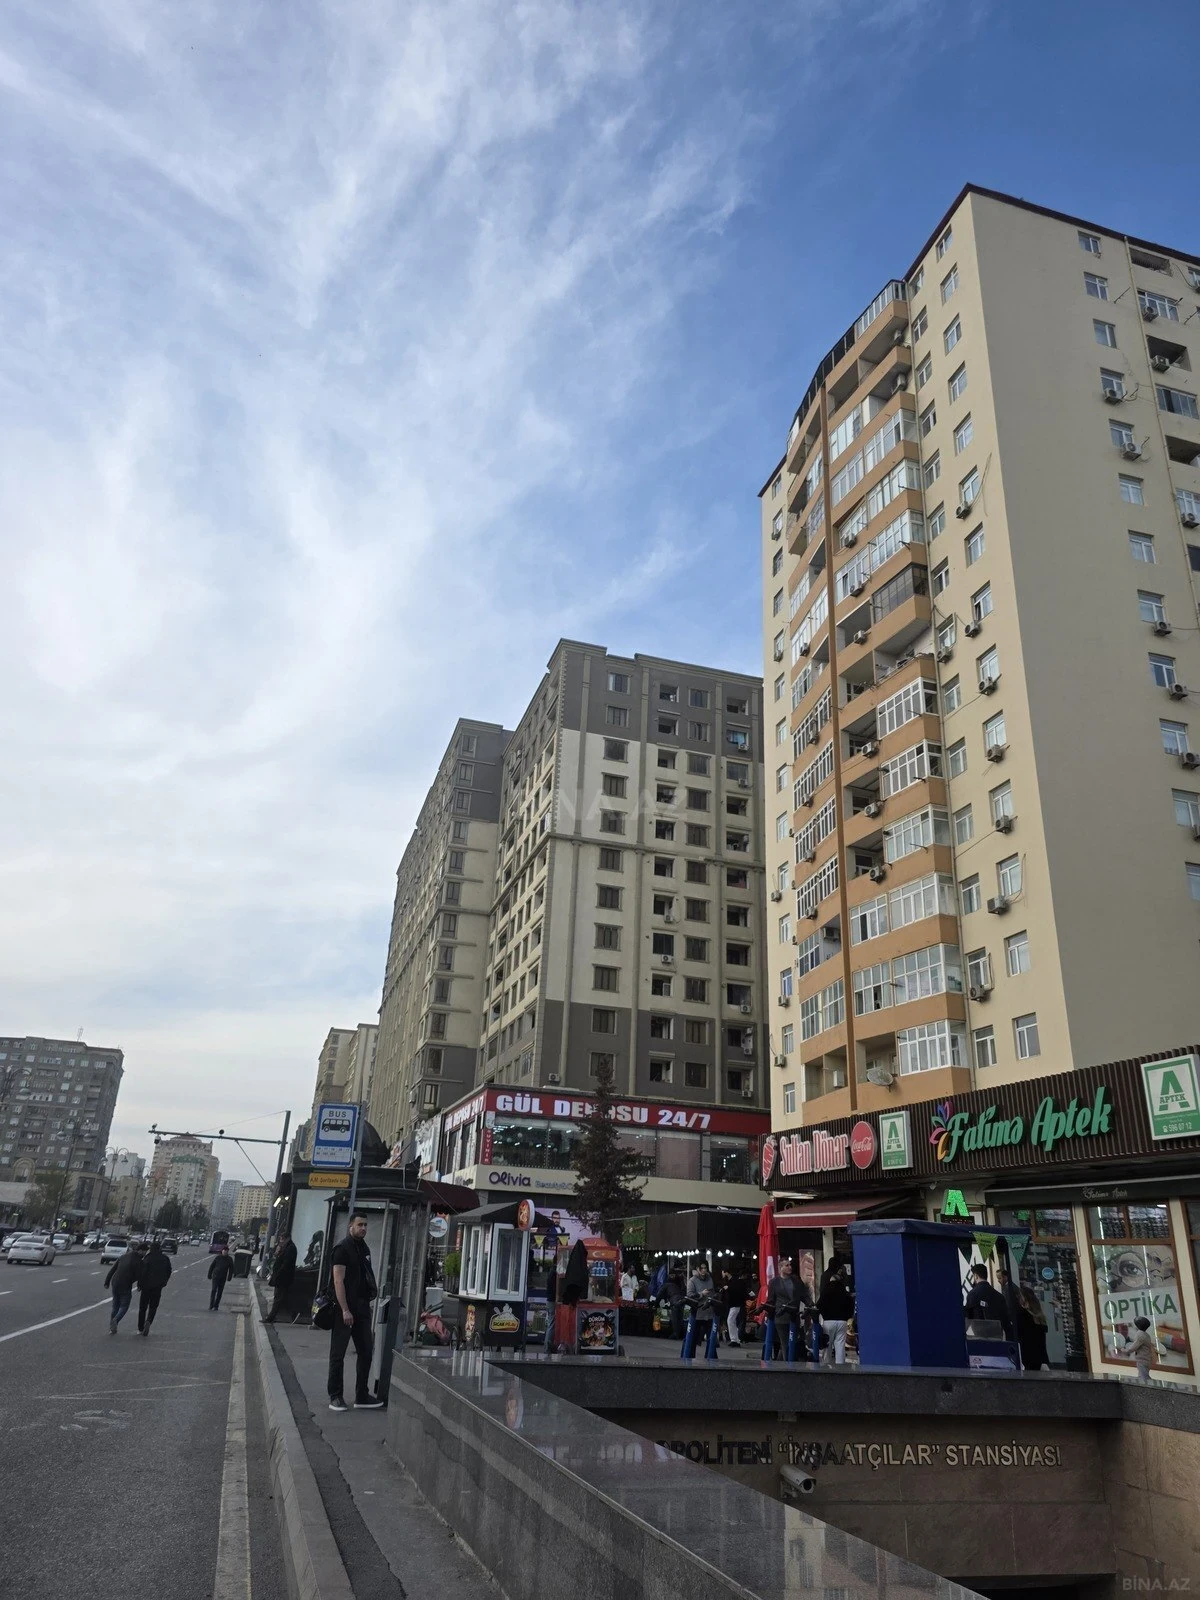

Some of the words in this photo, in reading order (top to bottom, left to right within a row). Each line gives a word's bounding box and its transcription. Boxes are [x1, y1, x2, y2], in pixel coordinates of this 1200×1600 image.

[495, 1092, 543, 1114] GÜL
[657, 1108, 711, 1129] 24/7
[1159, 1093, 1187, 1104] APTEK
[328, 1110, 347, 1118] BUS
[1030, 1086, 1113, 1152] Aptek
[779, 1133, 813, 1176] Sultan
[488, 1171, 531, 1187] Olivia
[1104, 1291, 1178, 1320] OPTİKA
[945, 1439, 1063, 1466] STANSİYASI
